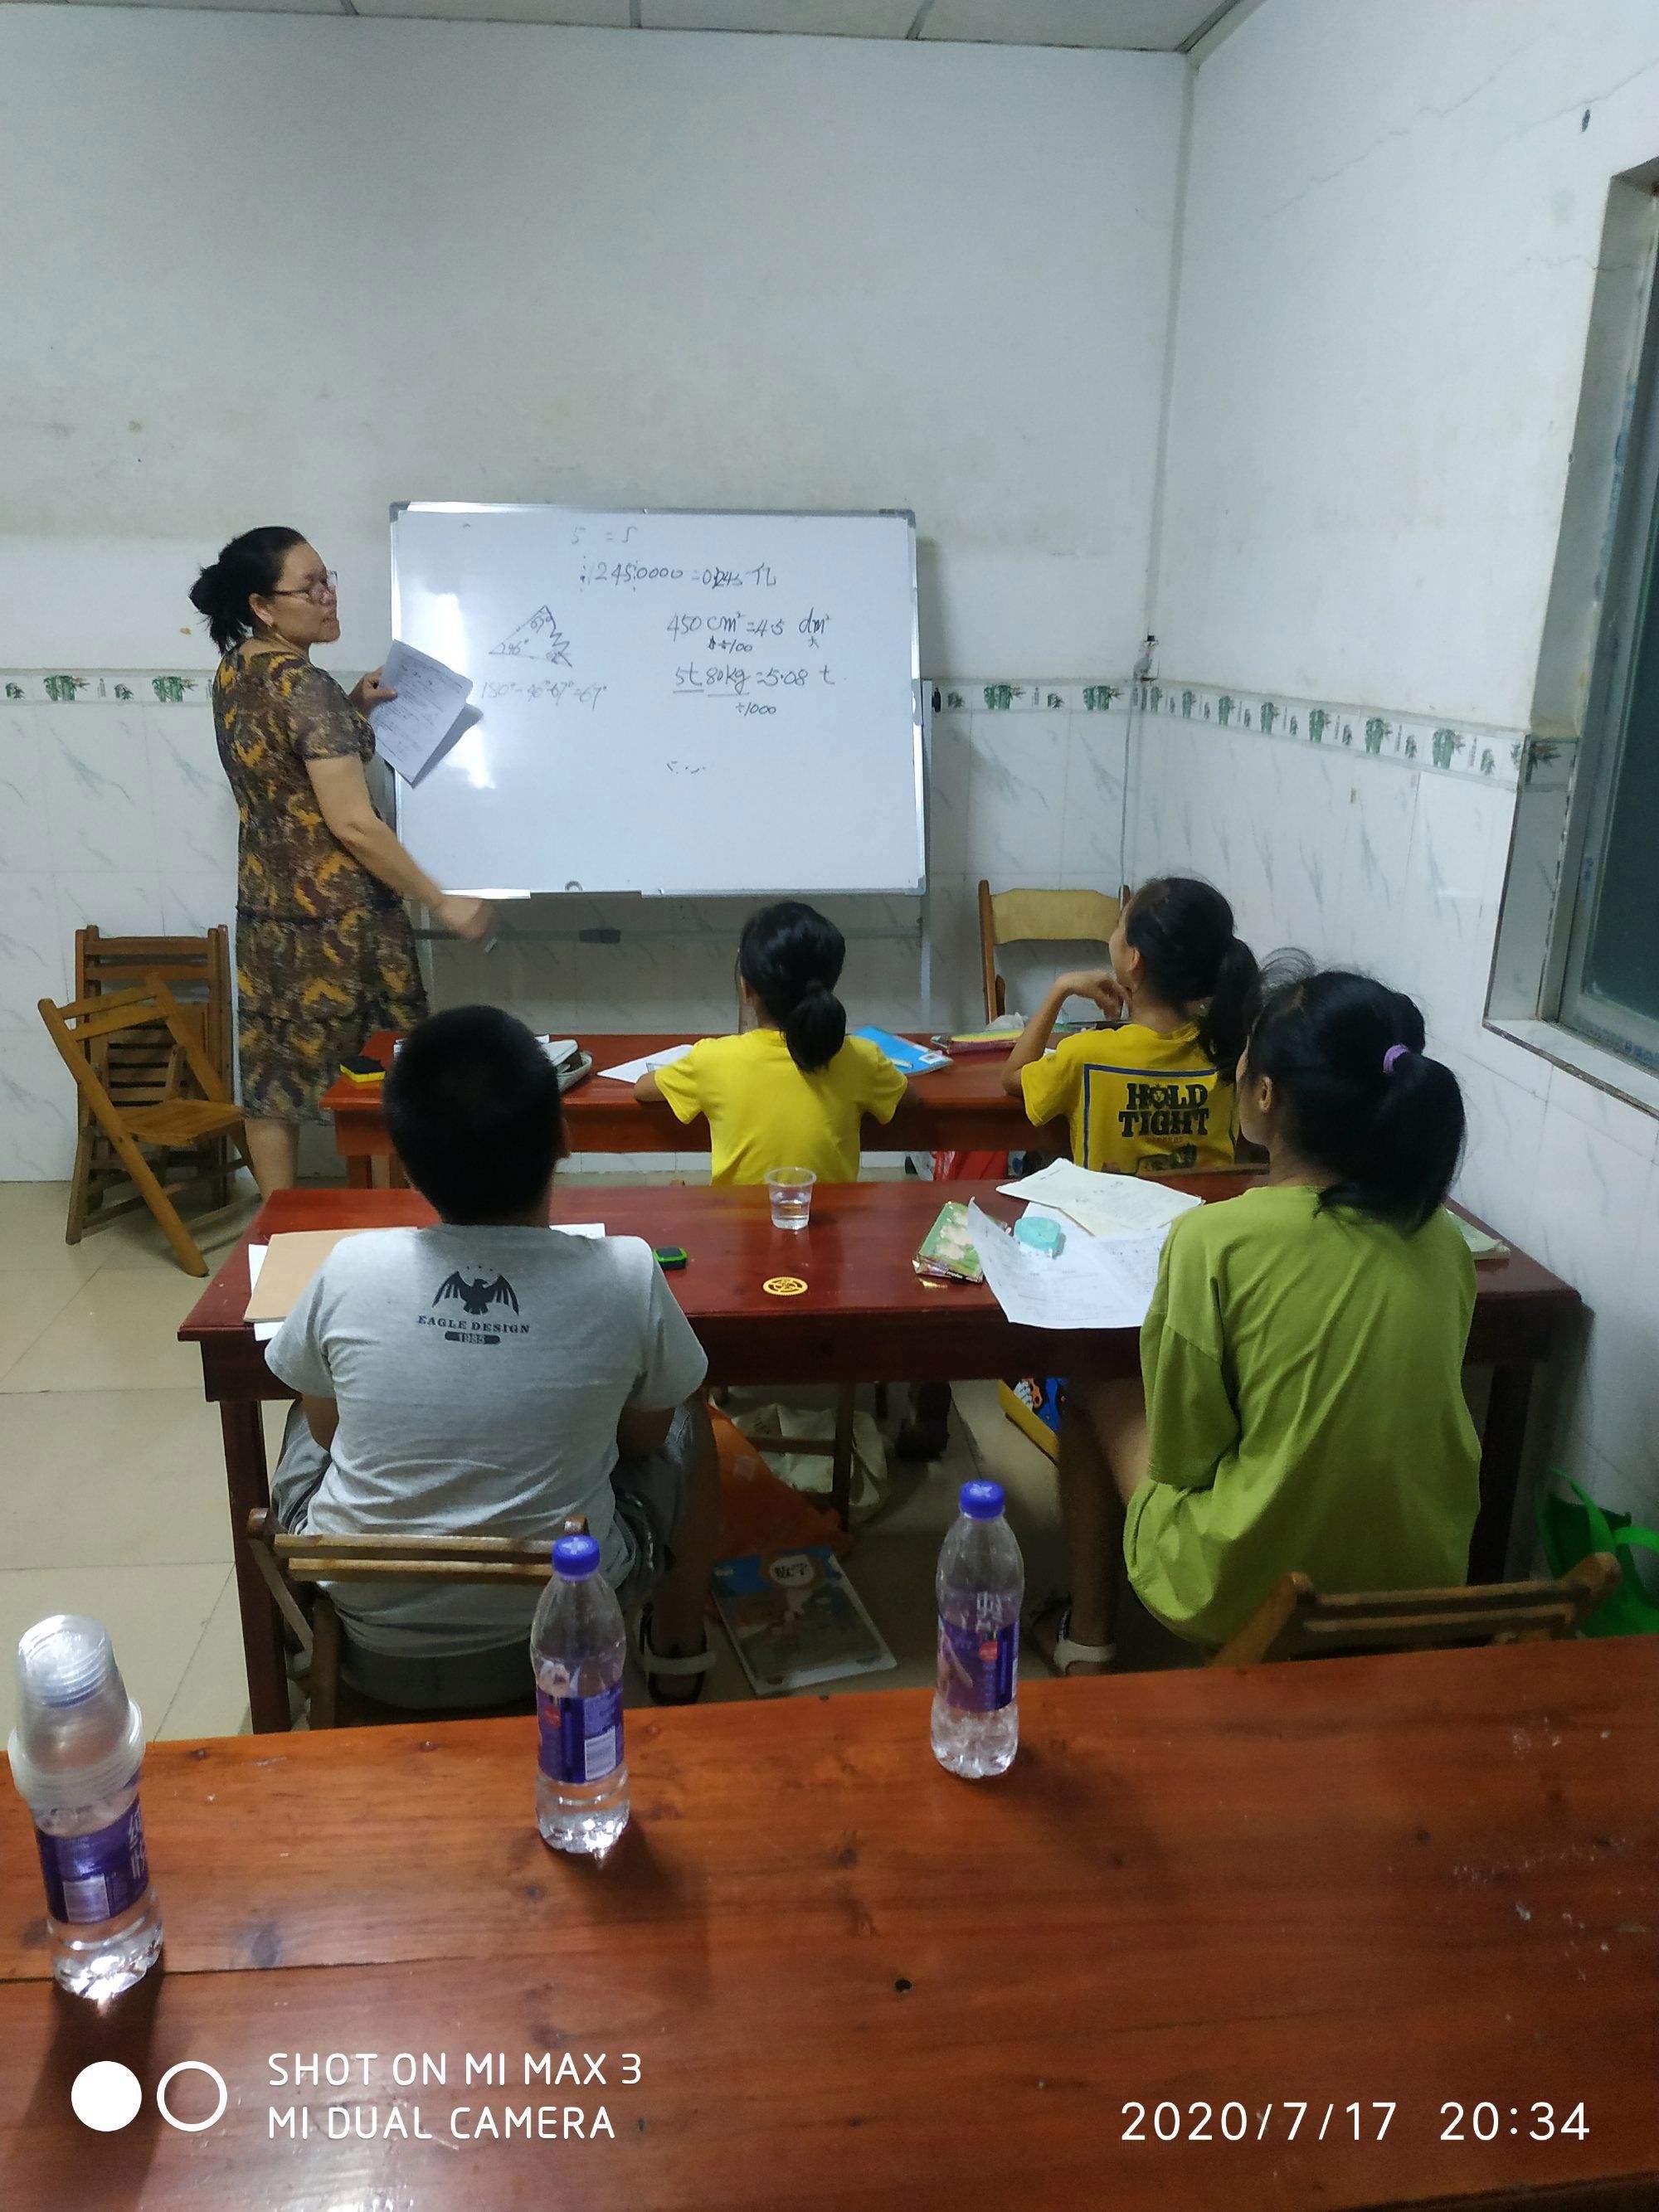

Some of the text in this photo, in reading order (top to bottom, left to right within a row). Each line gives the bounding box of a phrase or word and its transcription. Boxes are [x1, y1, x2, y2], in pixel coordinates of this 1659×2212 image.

[1126, 1082, 1209, 1110] HOLD
[1118, 1108, 1210, 1138] TIGHT
[417, 1315, 530, 1334] EAGLE DESIGN
